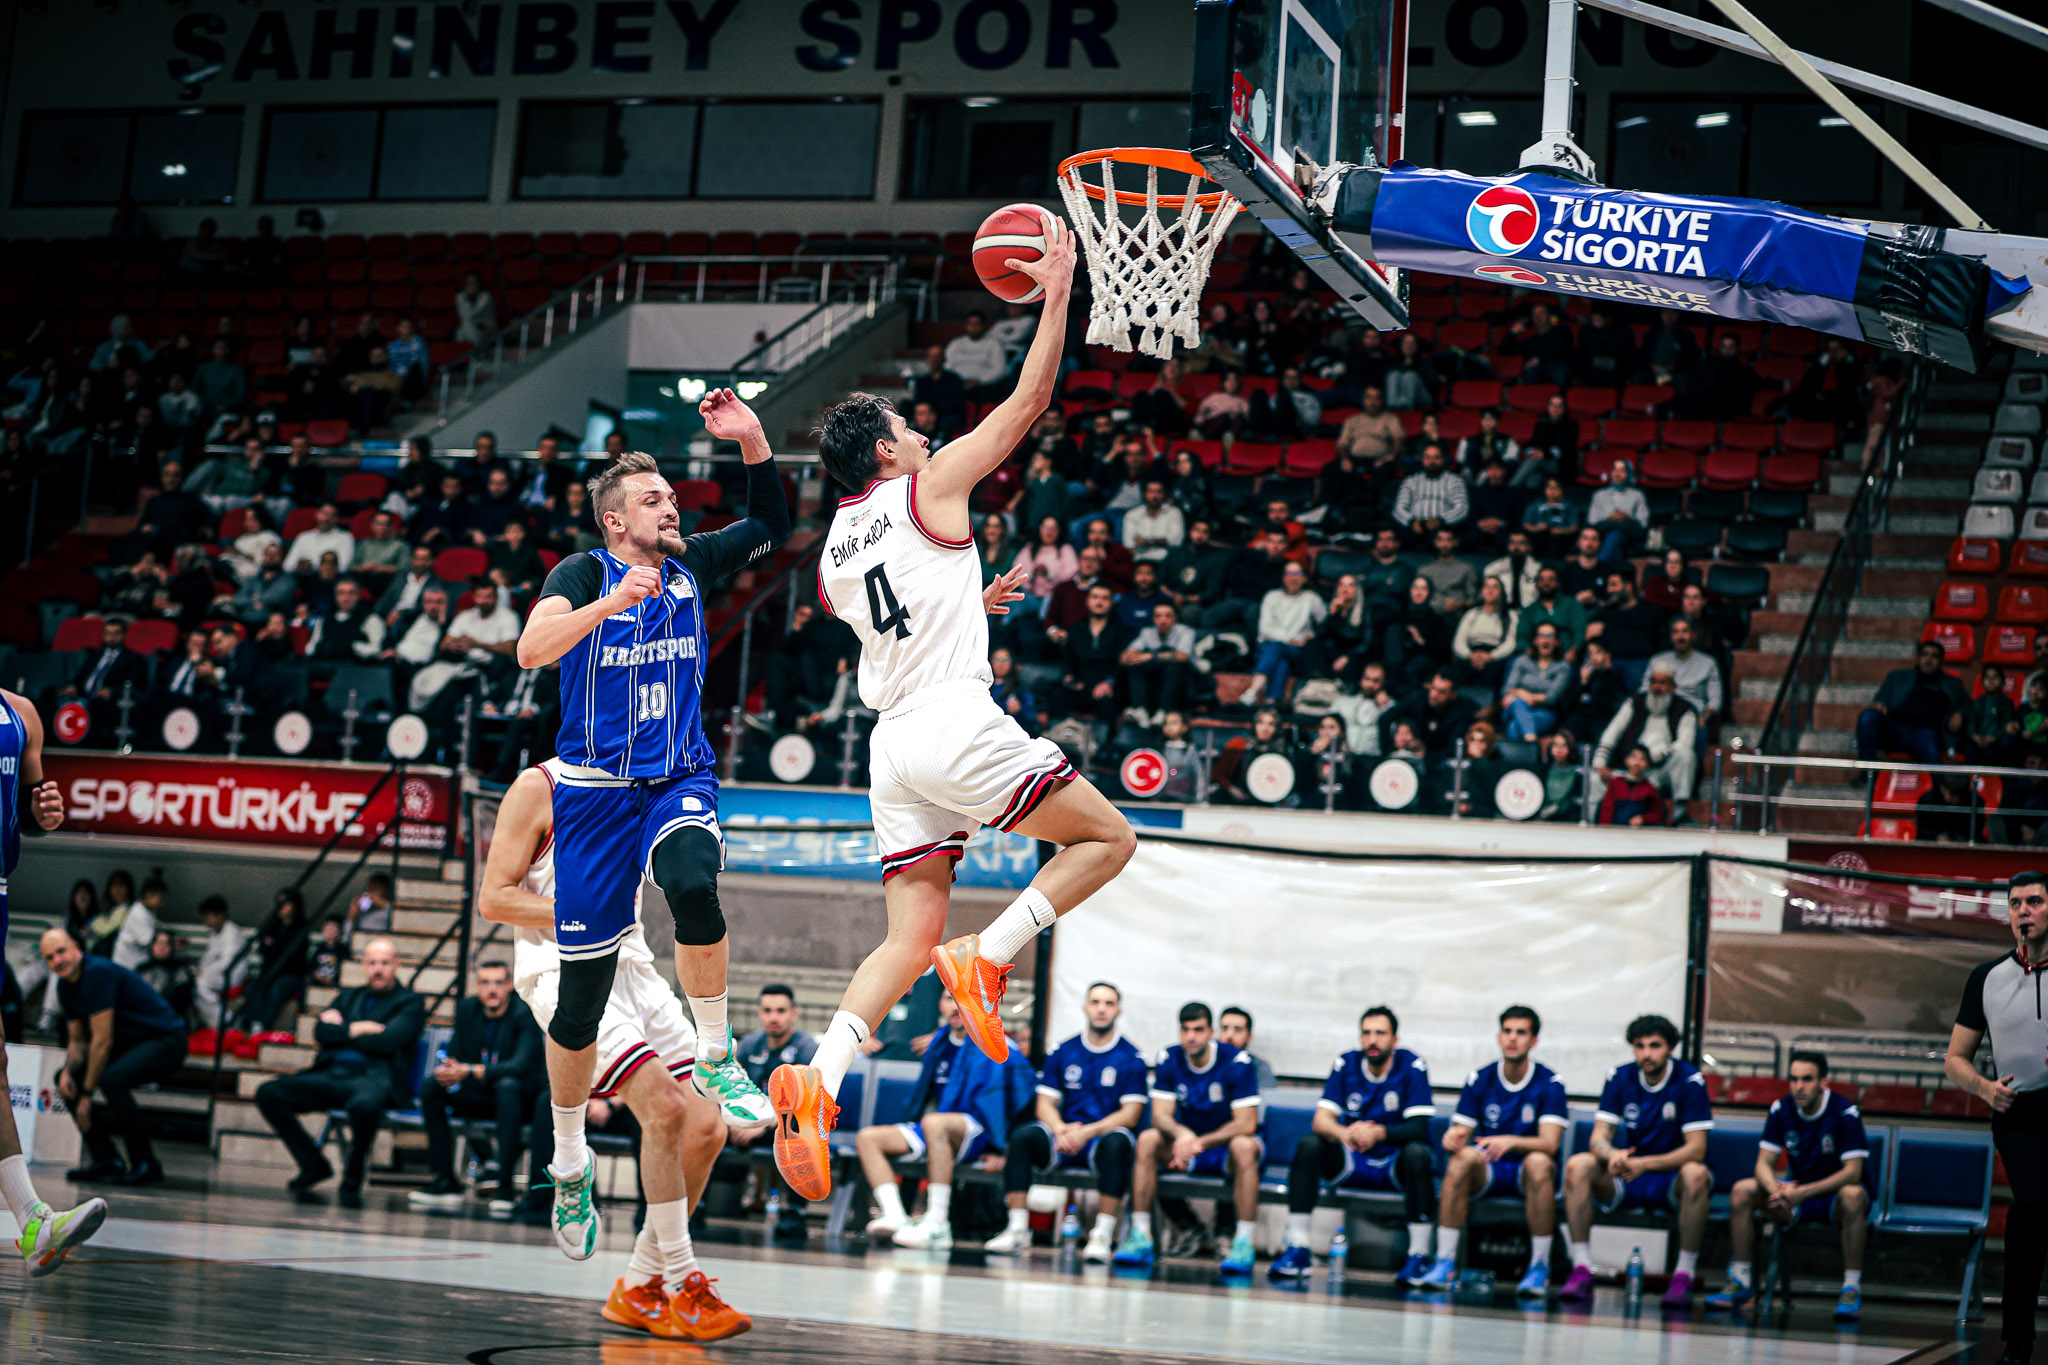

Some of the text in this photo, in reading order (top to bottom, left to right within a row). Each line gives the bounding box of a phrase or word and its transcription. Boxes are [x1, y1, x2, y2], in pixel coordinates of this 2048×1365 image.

[795, 0, 1120, 71] SPOR
[830, 512, 893, 568] EMİR ARDA
[864, 561, 913, 641] 4
[600, 637, 697, 668] KAĞITSPOR
[638, 681, 667, 722] 10
